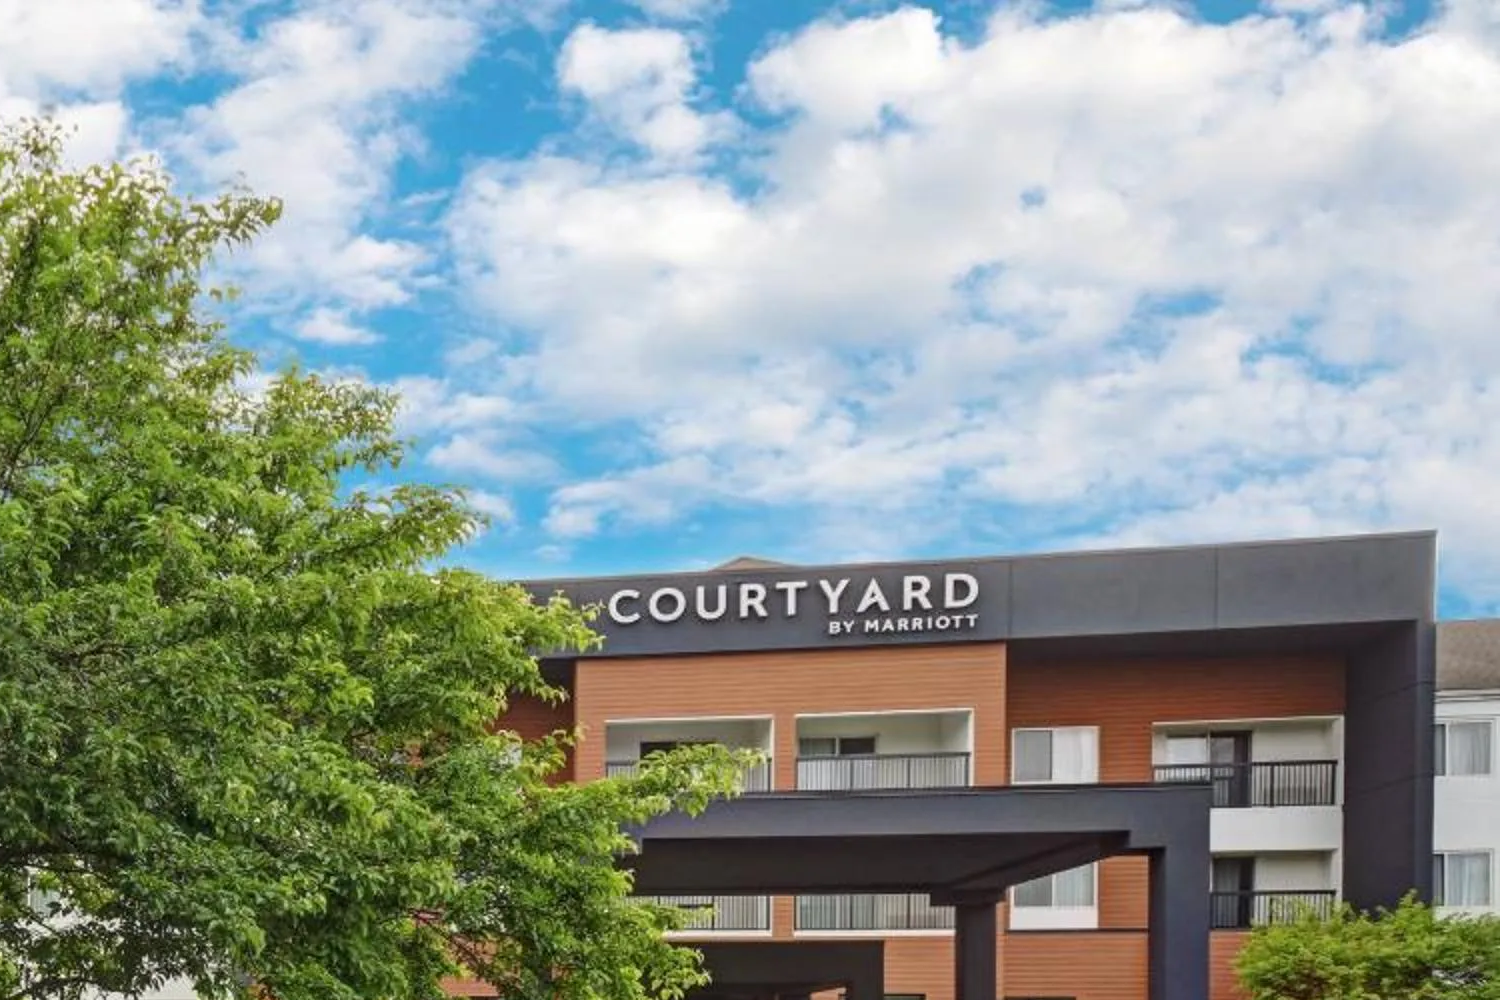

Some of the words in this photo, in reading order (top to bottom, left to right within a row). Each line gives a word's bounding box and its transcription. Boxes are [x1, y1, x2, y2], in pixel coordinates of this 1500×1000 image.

[607, 572, 980, 624] COURTYARD
[828, 619, 855, 635] BY
[864, 613, 979, 633] MARRIOTT
